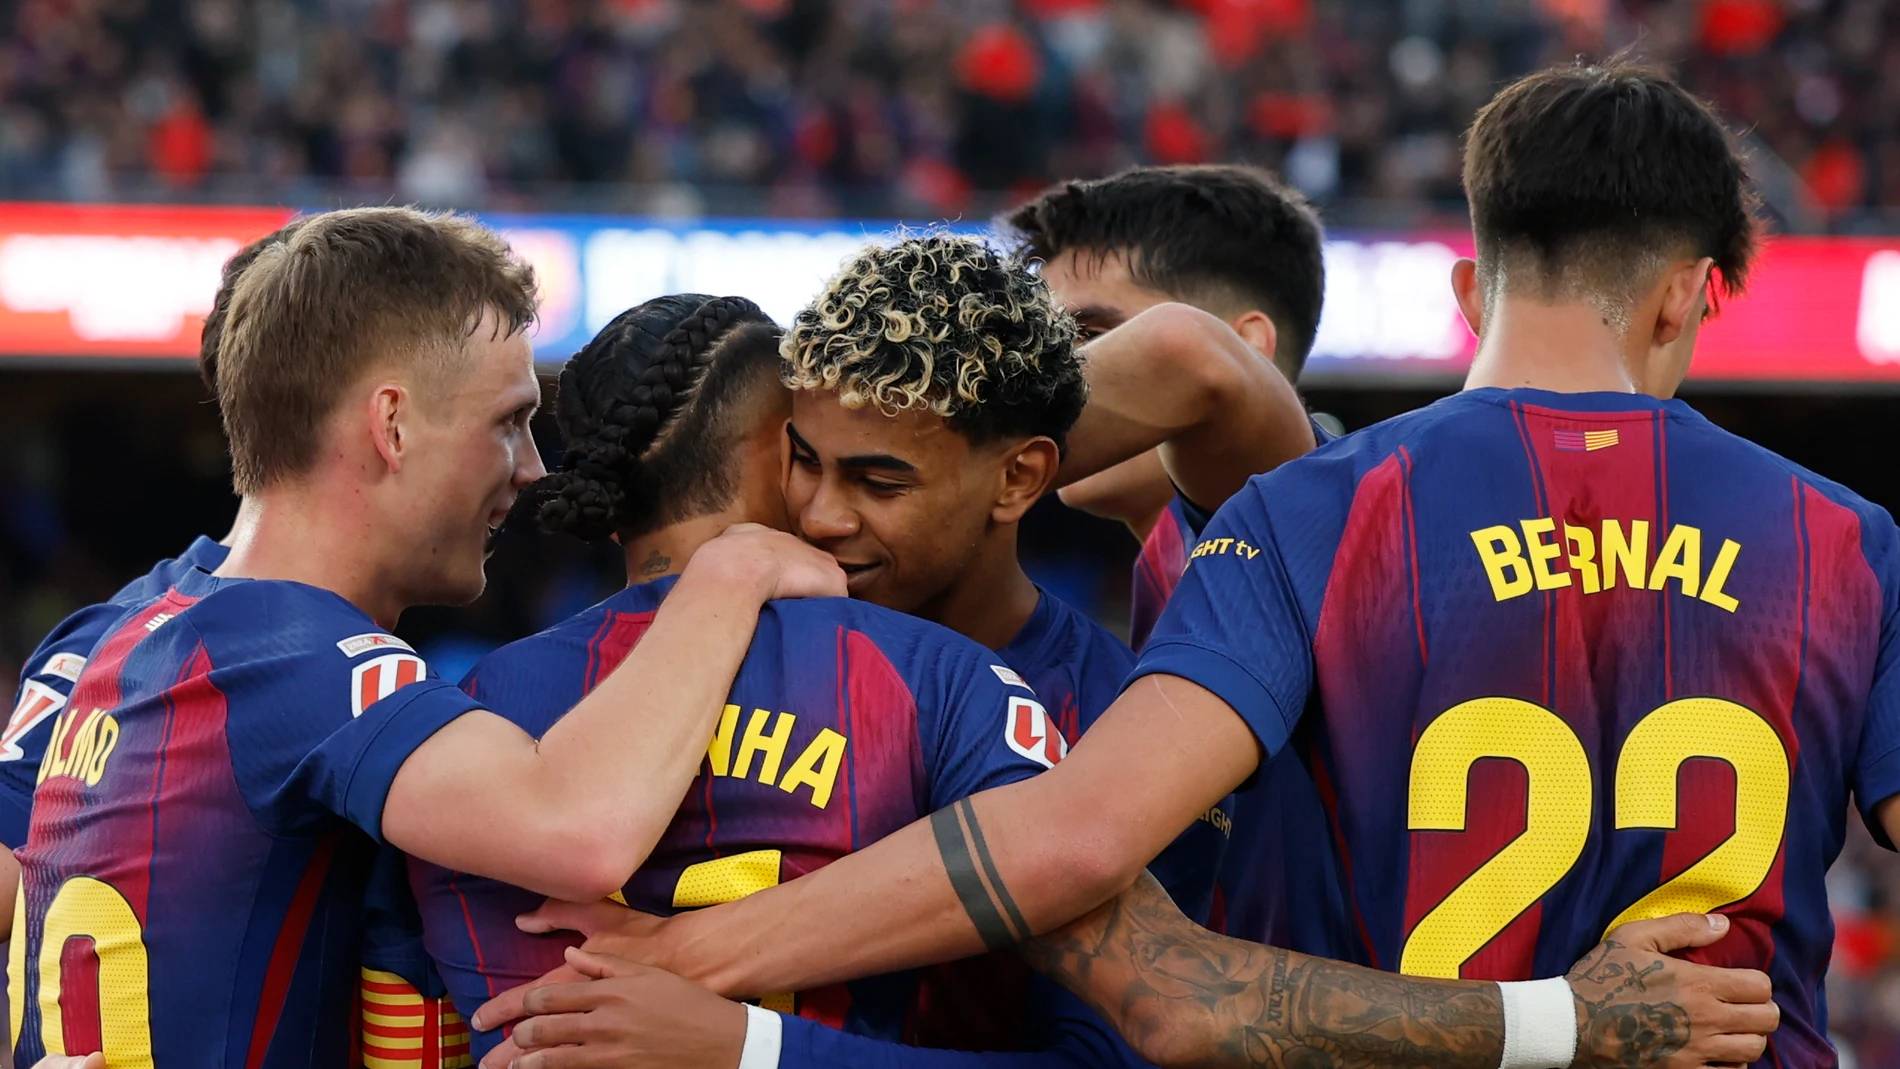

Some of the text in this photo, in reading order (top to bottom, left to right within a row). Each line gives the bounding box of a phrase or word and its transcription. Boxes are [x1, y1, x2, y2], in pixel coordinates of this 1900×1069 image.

[1189, 537, 1261, 560] GHT tv
[1469, 517, 1742, 614] BERNAL
[697, 703, 848, 810] NHA
[1399, 696, 1791, 980] 22
[6, 869, 155, 1069] 0
